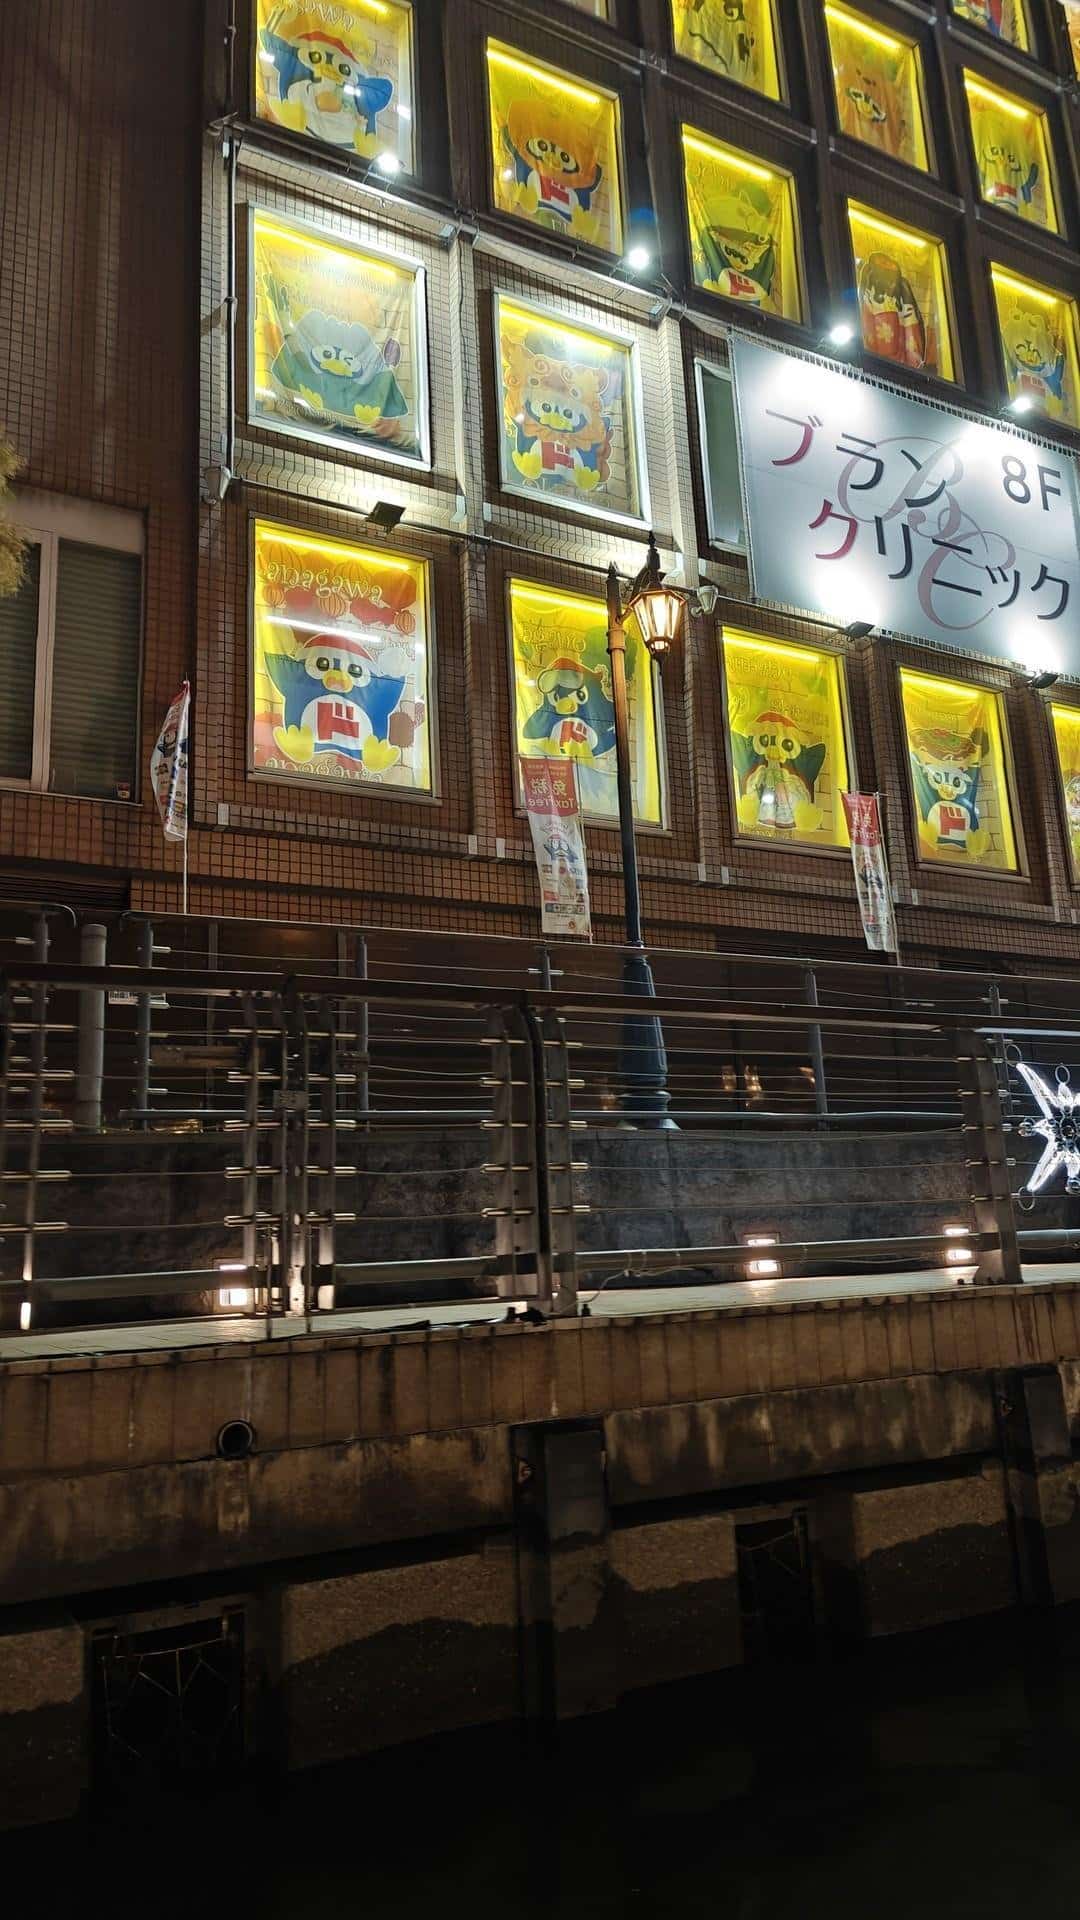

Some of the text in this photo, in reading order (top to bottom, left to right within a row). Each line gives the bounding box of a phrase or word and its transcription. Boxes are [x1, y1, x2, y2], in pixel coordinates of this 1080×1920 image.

[765, 408, 946, 508] ブラン
[1001, 455, 1061, 511] 8F
[808, 499, 1070, 620] クリニック
